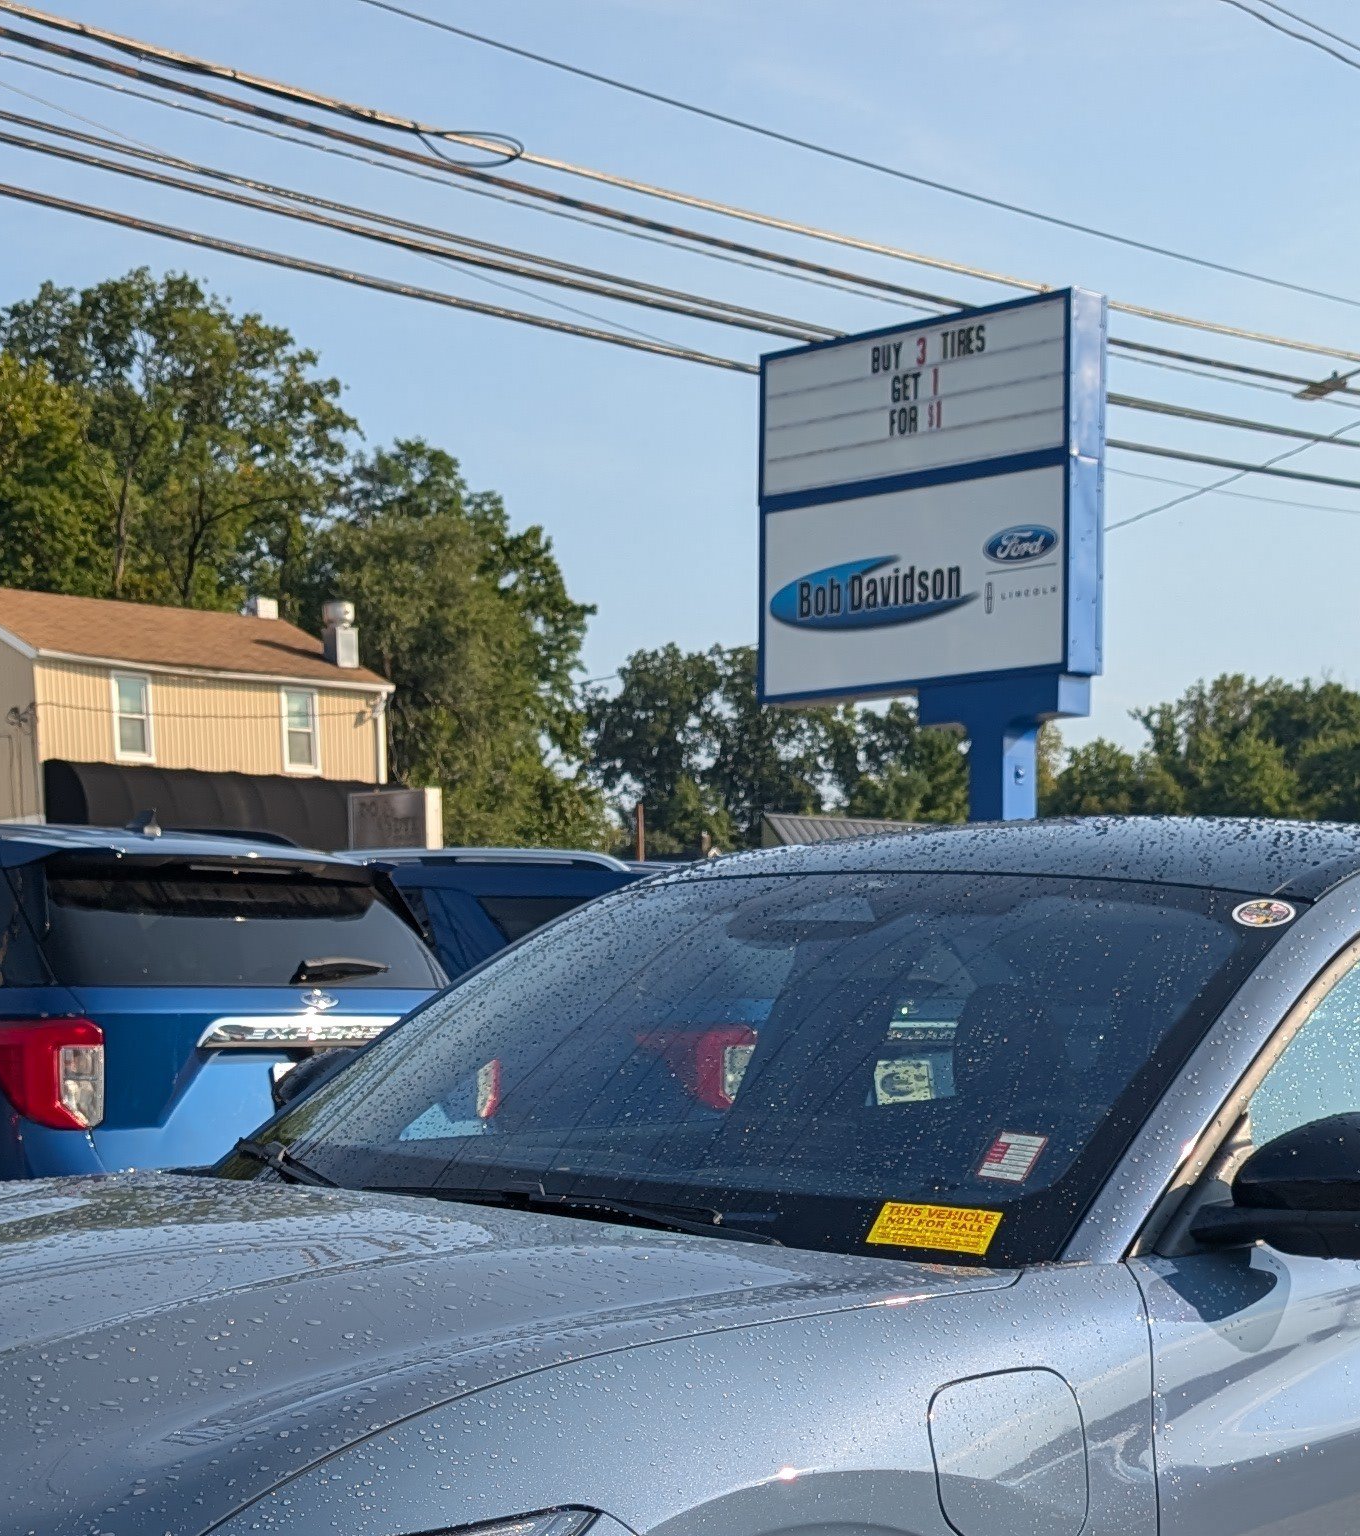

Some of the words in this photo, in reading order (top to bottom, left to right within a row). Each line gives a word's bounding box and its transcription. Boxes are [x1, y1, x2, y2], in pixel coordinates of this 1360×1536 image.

[871, 341, 902, 374] BUY
[916, 337, 927, 366] 3
[941, 324, 986, 359] TIRES
[891, 371, 922, 403] GET
[932, 367, 940, 396] 1
[889, 405, 918, 436] FOR
[928, 400, 942, 429] $1
[995, 528, 1045, 560] Ford
[798, 576, 842, 618] Bob
[848, 564, 962, 612] Davidson
[246, 1026, 385, 1041] EXPLORE
[885, 1216, 917, 1226] NOT
[916, 1218, 949, 1229] FOR
[950, 1221, 987, 1233] SALE
[889, 1205, 924, 1217] THIS
[927, 1207, 996, 1225] VEHICLE
